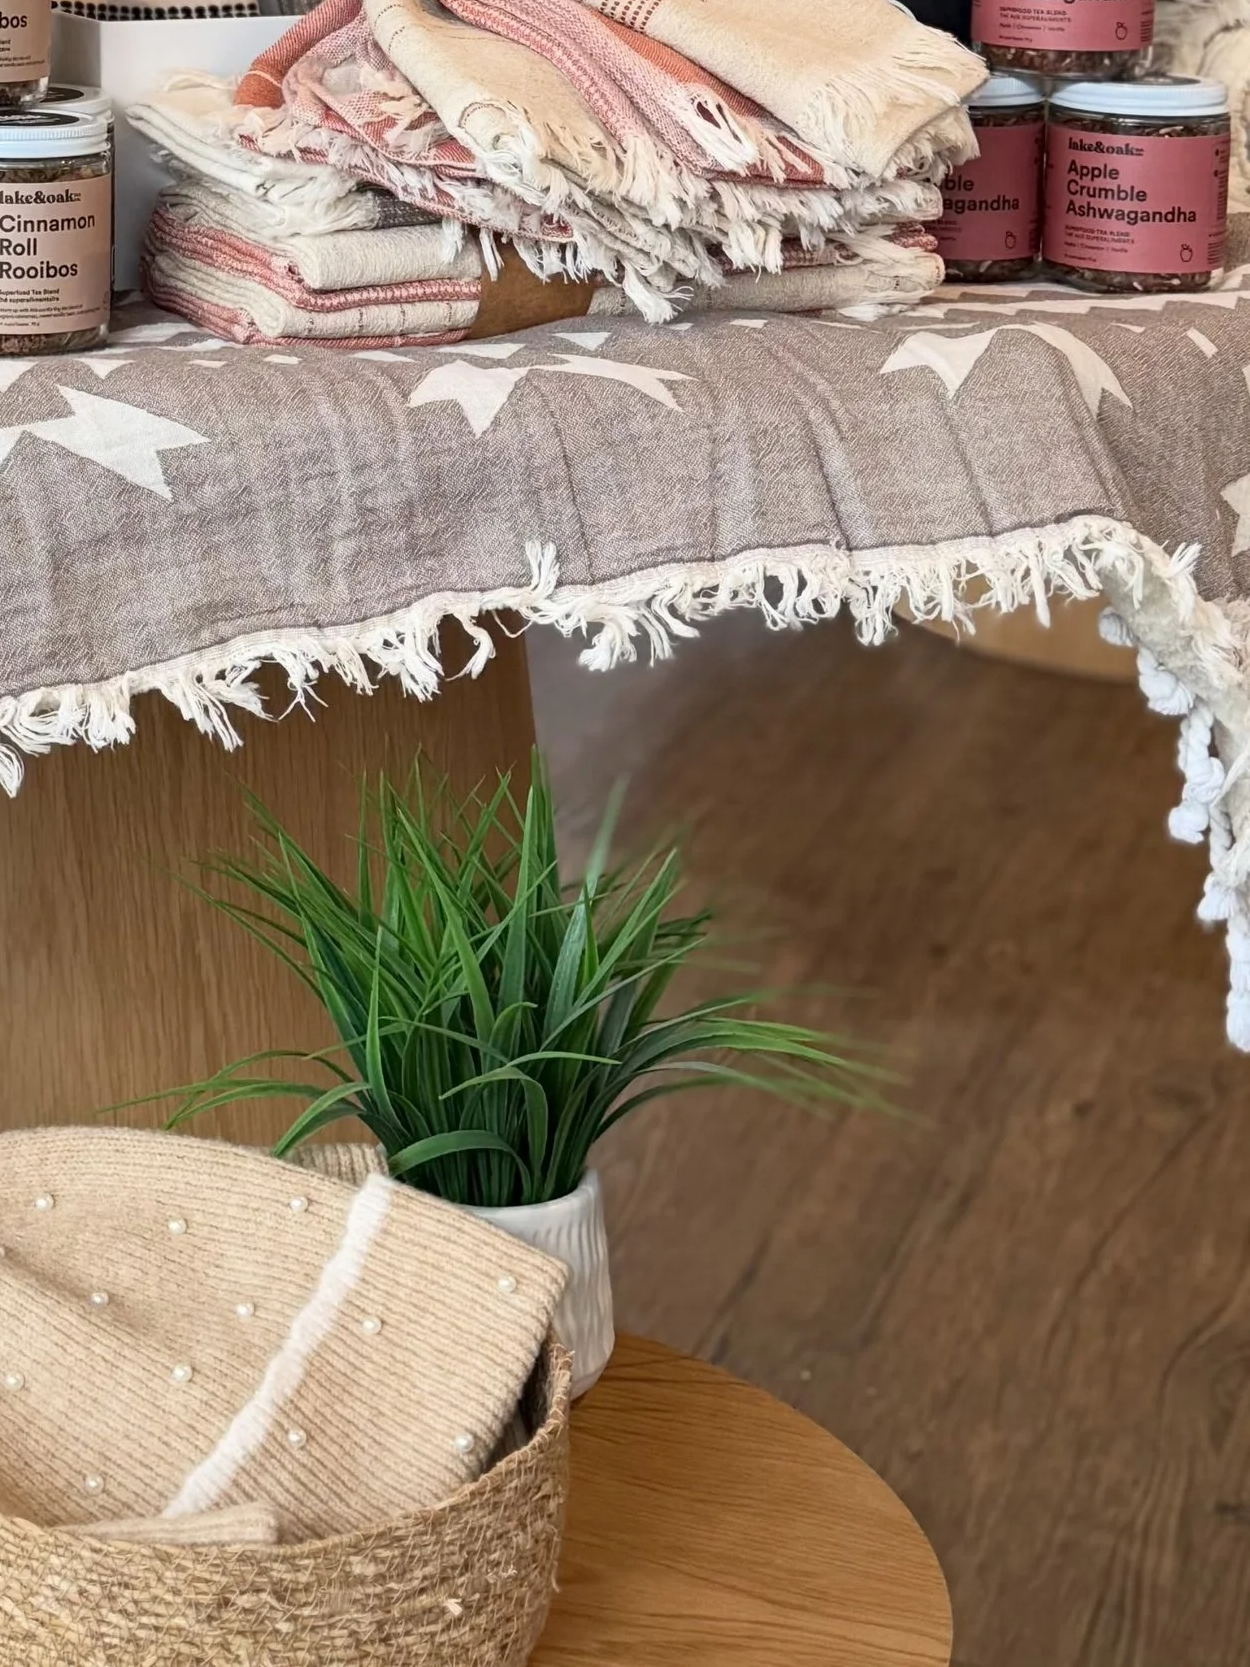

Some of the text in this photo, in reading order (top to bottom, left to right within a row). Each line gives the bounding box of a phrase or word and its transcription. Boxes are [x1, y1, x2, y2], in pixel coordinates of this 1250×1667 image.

[1068, 137, 1133, 156] lake&oak
[1067, 159, 1120, 181] Apple
[938, 174, 974, 191] ble
[1066, 180, 1147, 202] Crumble
[1066, 200, 1197, 226] Ashwagandha
[0, 238, 37, 256] Roll
[0, 260, 78, 279] Rooibos
